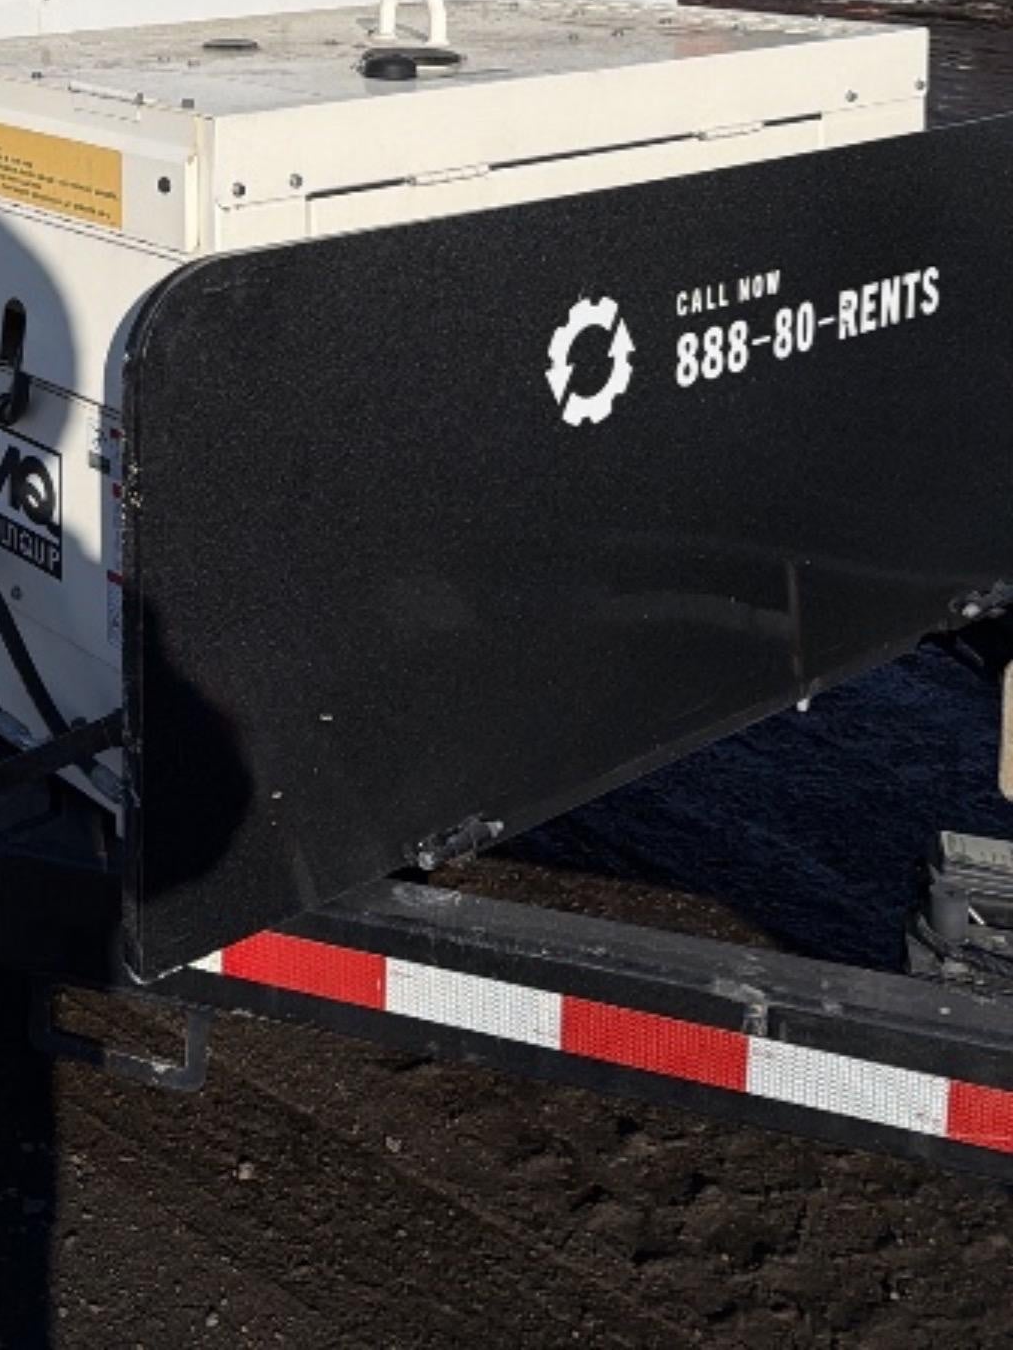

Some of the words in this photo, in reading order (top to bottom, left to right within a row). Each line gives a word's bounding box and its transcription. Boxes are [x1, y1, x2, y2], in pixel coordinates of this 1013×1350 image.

[676, 283, 729, 317] CALL
[738, 269, 781, 302] NOW
[676, 266, 940, 388] 888-80-RENTS
